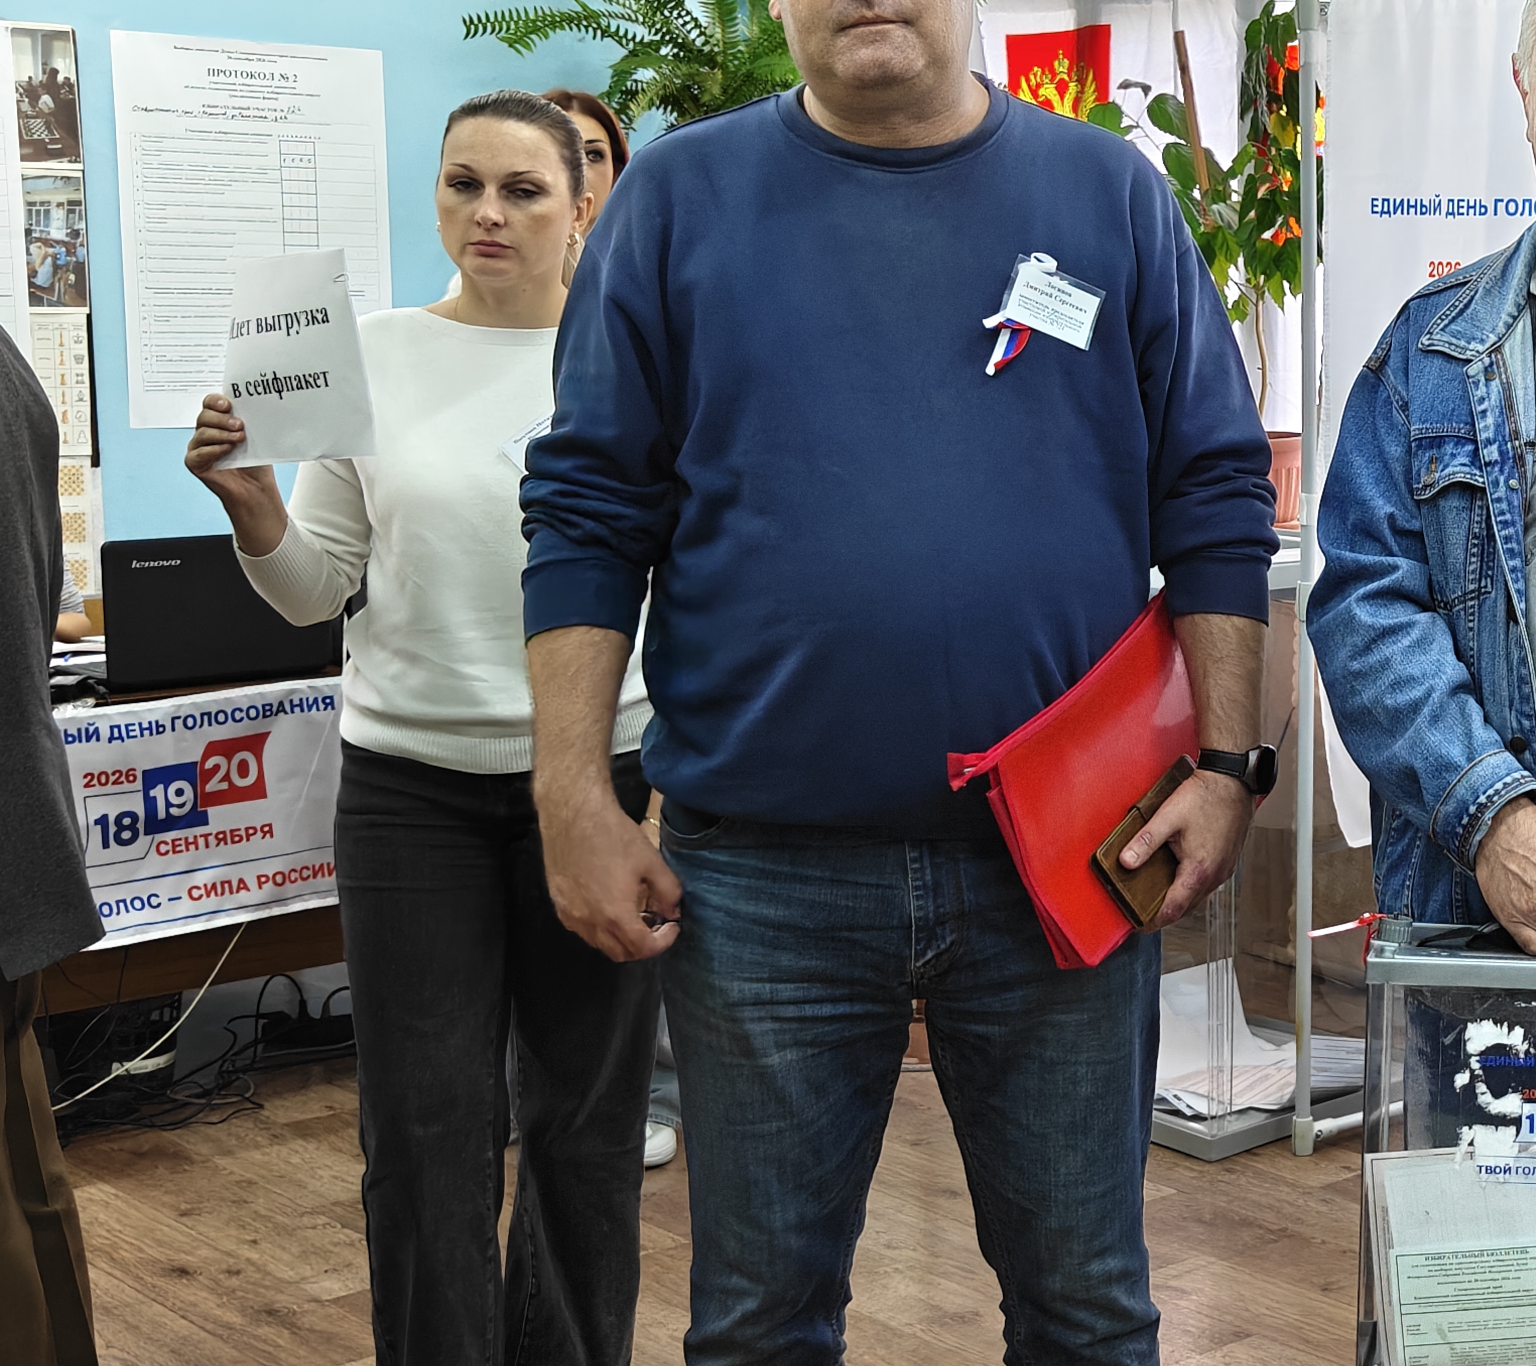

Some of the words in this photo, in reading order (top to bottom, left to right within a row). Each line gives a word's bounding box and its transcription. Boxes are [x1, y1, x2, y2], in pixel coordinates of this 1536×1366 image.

[207, 67, 274, 82] ПРОТОКОЛ
[292, 73, 298, 83] 2
[1370, 194, 1442, 218] ЕДИНЫЙ
[1445, 198, 1488, 219] ДЕНЬ
[256, 307, 330, 337] выгрузка
[231, 383, 242, 399] в
[245, 370, 329, 400] сейфпакет
[131, 559, 181, 569] lenovo
[108, 722, 166, 744] ДЕНЬ
[171, 695, 336, 733] ГОЛОСОВАНИЯ
[82, 768, 138, 789] 2026
[94, 810, 140, 850] 18
[149, 780, 195, 821] 19
[204, 750, 259, 793] 20
[155, 823, 274, 857] СЕНТЯБРЯ
[98, 893, 162, 918] ОЛОС
[187, 877, 250, 902] СИЛА
[1481, 1052, 1535, 1068] ЕДИНЫЙ
[1477, 1163, 1512, 1176] ТВОЙ
